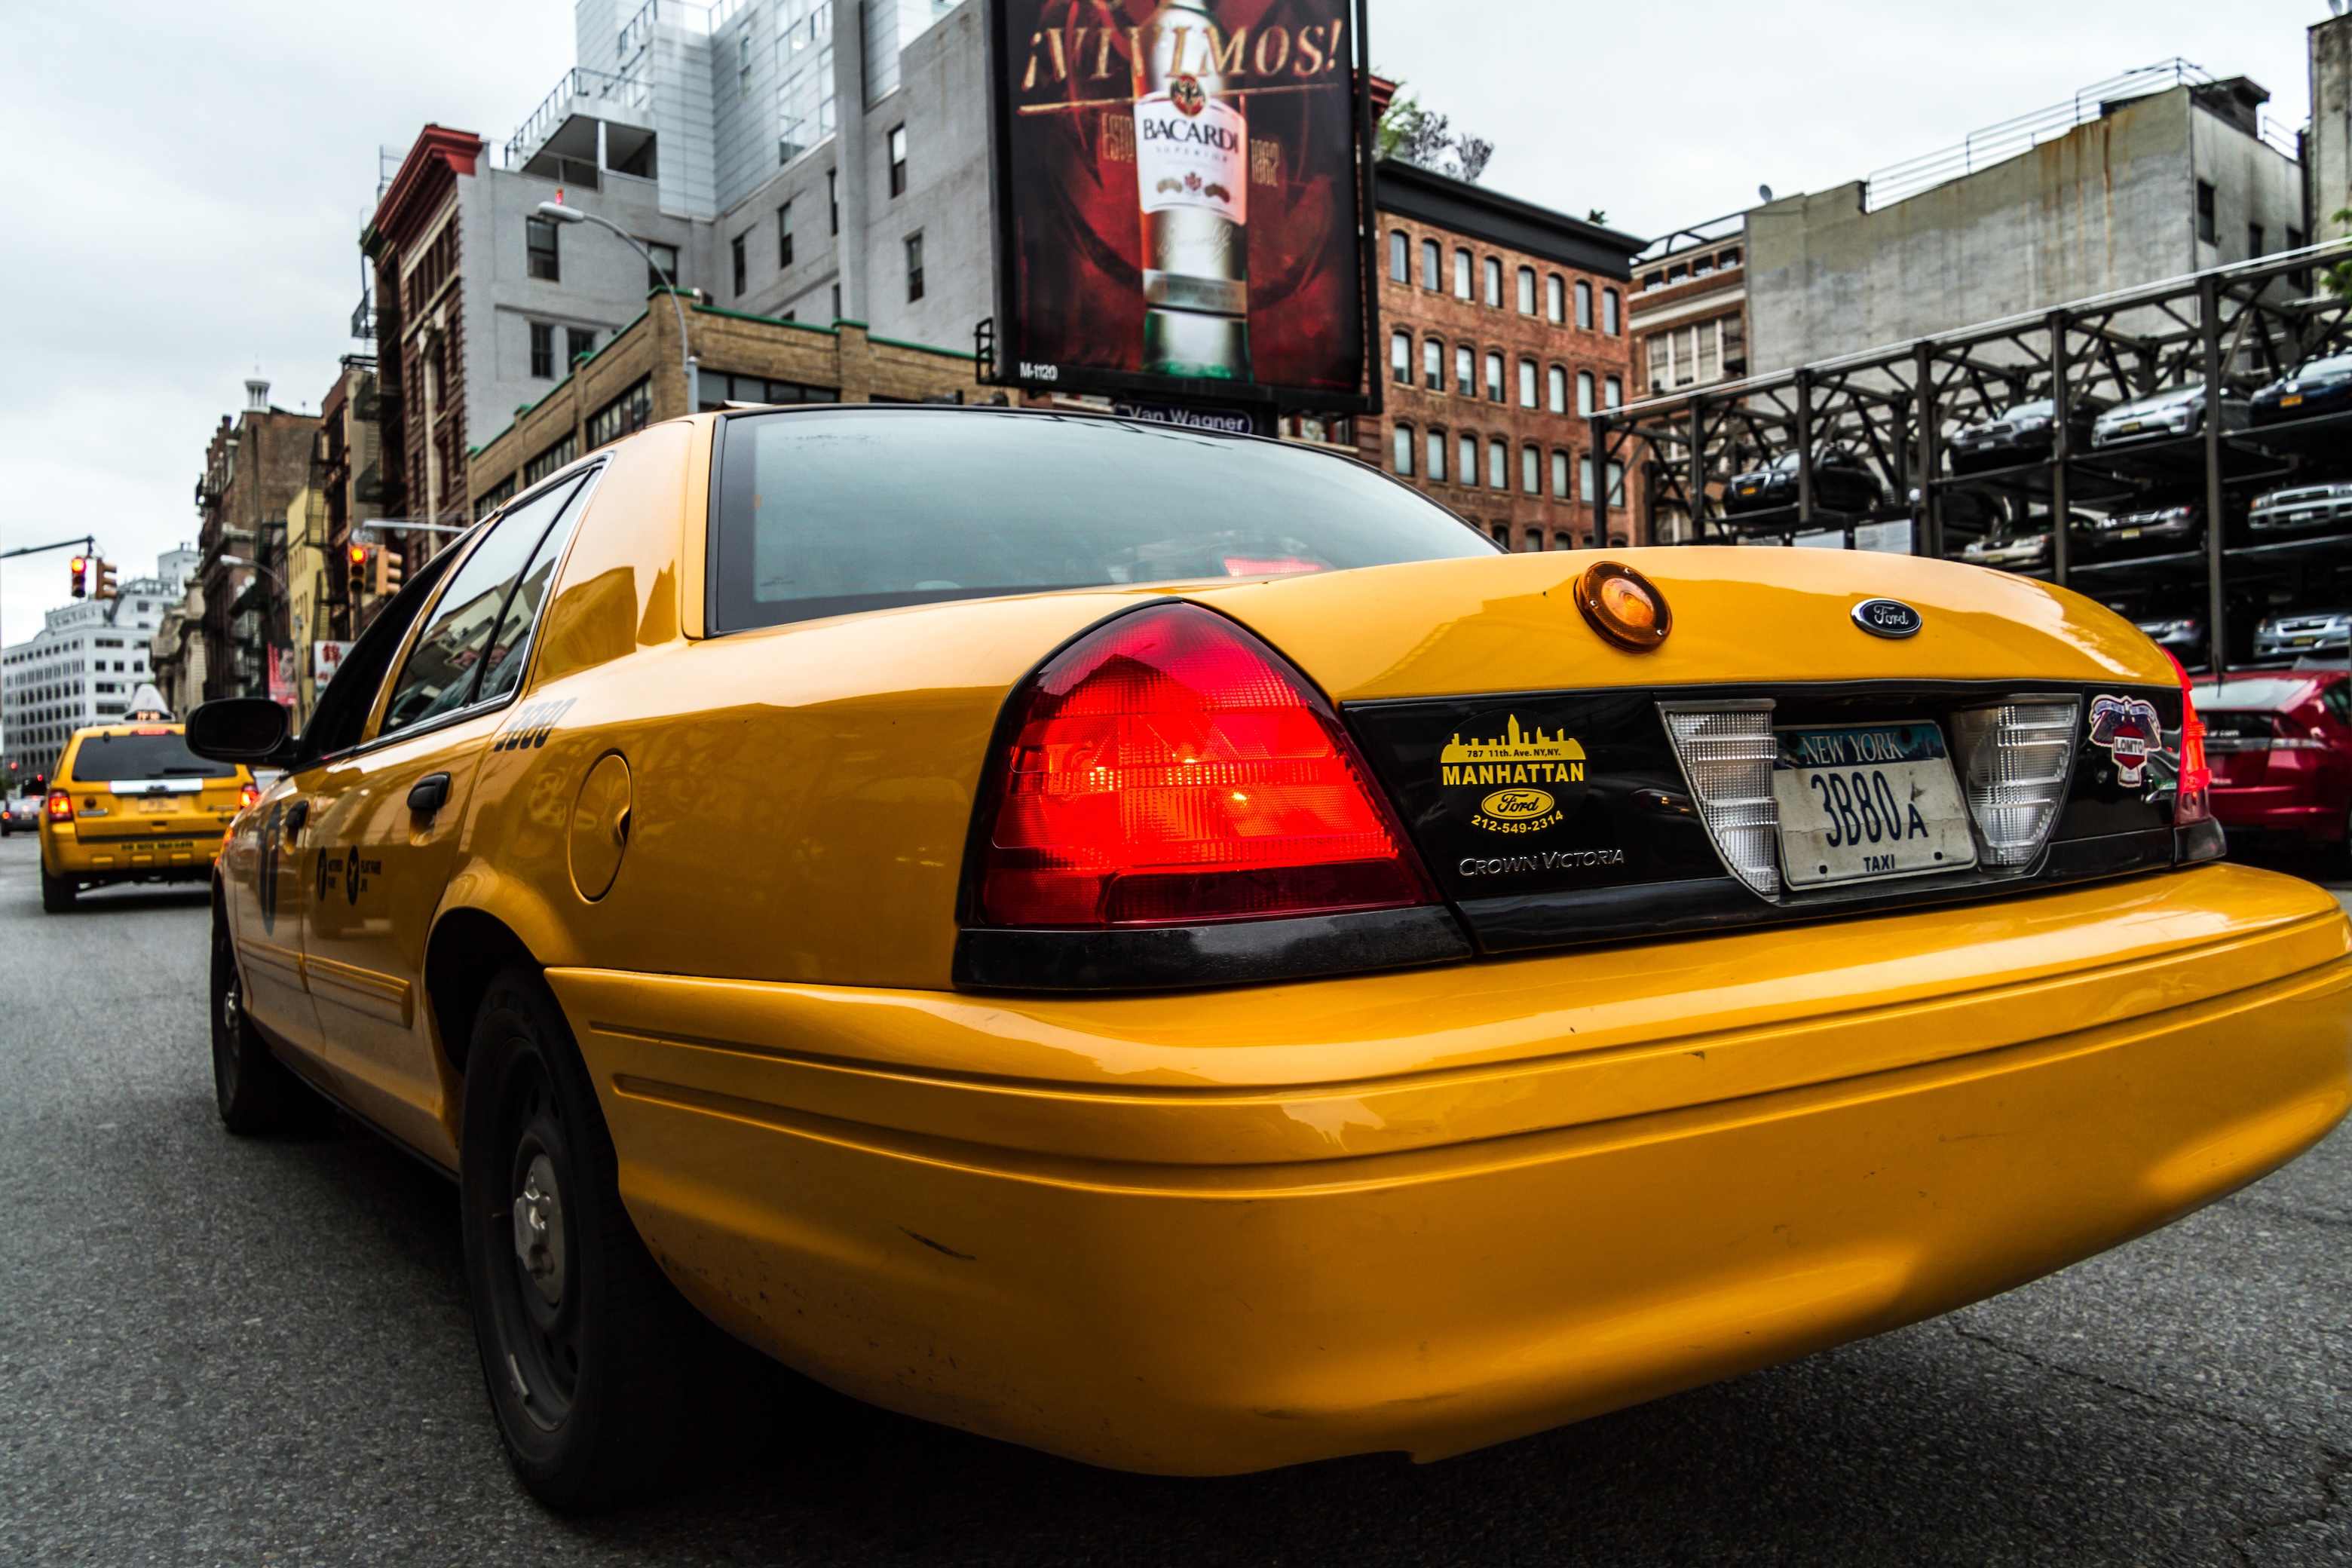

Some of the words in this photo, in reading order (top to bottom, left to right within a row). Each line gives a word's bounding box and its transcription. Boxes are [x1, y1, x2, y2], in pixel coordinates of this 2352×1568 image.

[1144, 118, 1239, 153] BACARDI
[1019, 362, 1058, 381] M-1120
[1129, 405, 1165, 421] Van
[1169, 409, 1245, 431] Wagner
[1873, 605, 1909, 625] Ford
[1467, 749, 1484, 758] 787
[1489, 749, 1511, 758] 11th.
[1514, 749, 1532, 757] Ave.
[1802, 735, 1845, 764] NEW
[1848, 732, 1904, 762] YORK
[2115, 739, 2142, 754] LOMTO
[1442, 762, 1584, 786] MANHATTAN
[1497, 793, 1539, 813] Ford
[1472, 810, 1563, 834] 212-549-2314
[1459, 856, 1537, 877] CROWN
[1542, 849, 1625, 869] VICTORIA
[1864, 854, 1895, 872] TAXI
